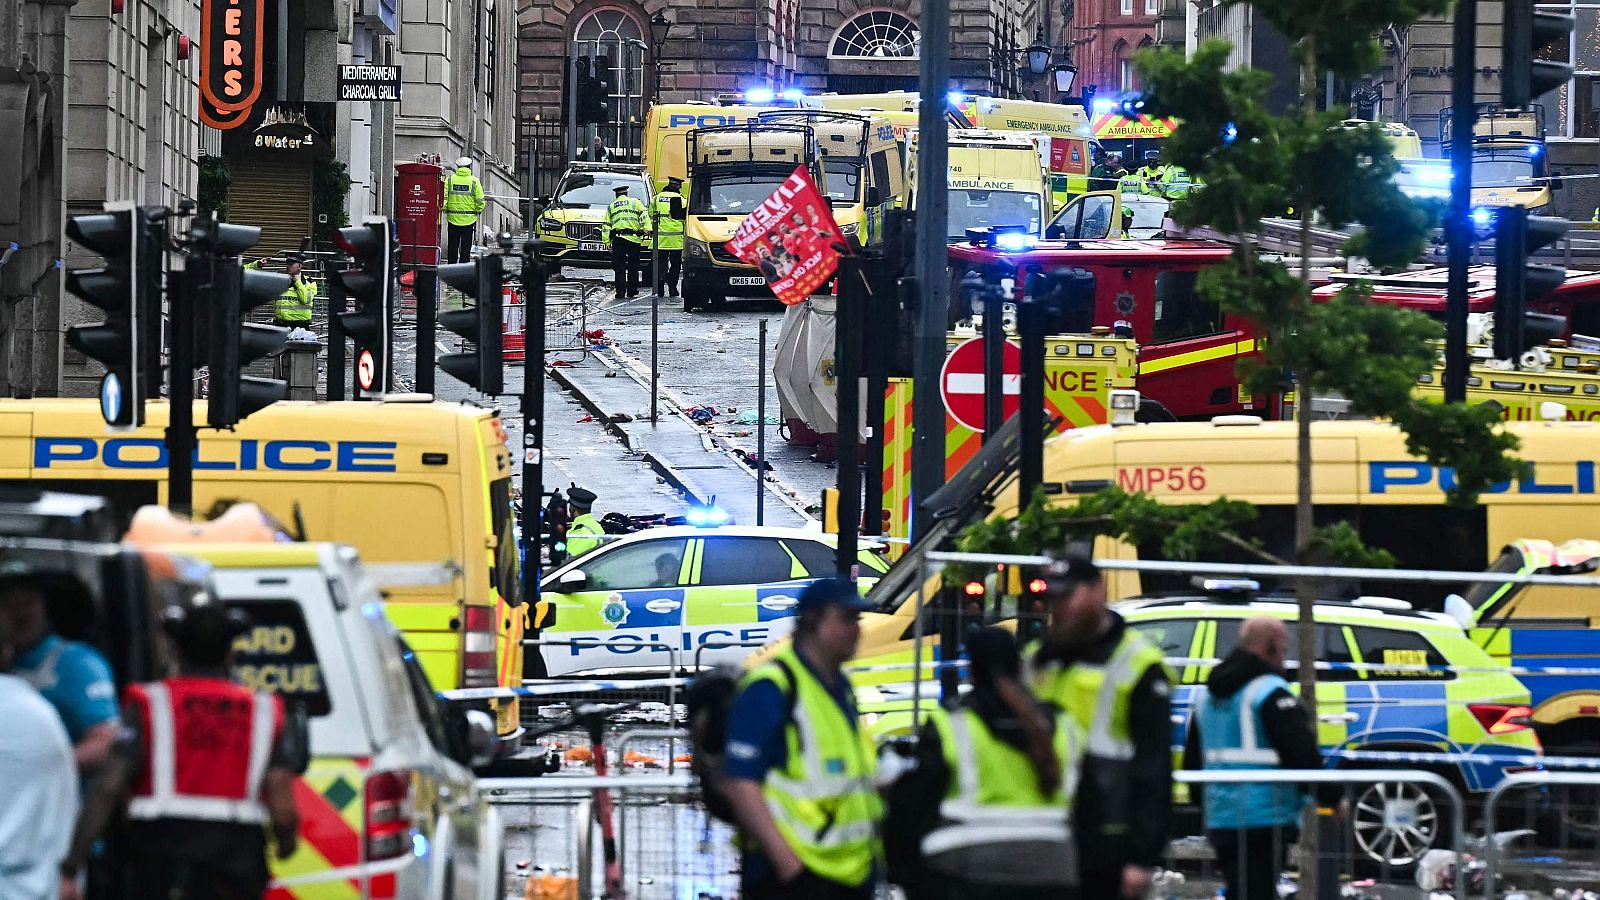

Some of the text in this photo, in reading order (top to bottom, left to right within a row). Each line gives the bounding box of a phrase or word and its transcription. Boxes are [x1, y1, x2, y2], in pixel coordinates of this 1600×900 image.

[223, 0, 243, 96] ERS
[342, 65, 397, 81] MEDITERRANEAN
[342, 85, 398, 99] CHARCOAL GRILL
[1006, 119, 1072, 133] EMERGENCY AMBULANCE
[1107, 126, 1164, 135] AMBULANCE
[255, 135, 264, 147] 8
[264, 135, 302, 149] Water
[947, 180, 1014, 190] AMBULANCE
[1043, 370, 1098, 393] NCE
[34, 437, 397, 473] POLICE
[1118, 466, 1206, 493] MP56
[232, 626, 295, 654] ARD
[570, 627, 770, 657] POLICE
[239, 664, 320, 693] SCUE
